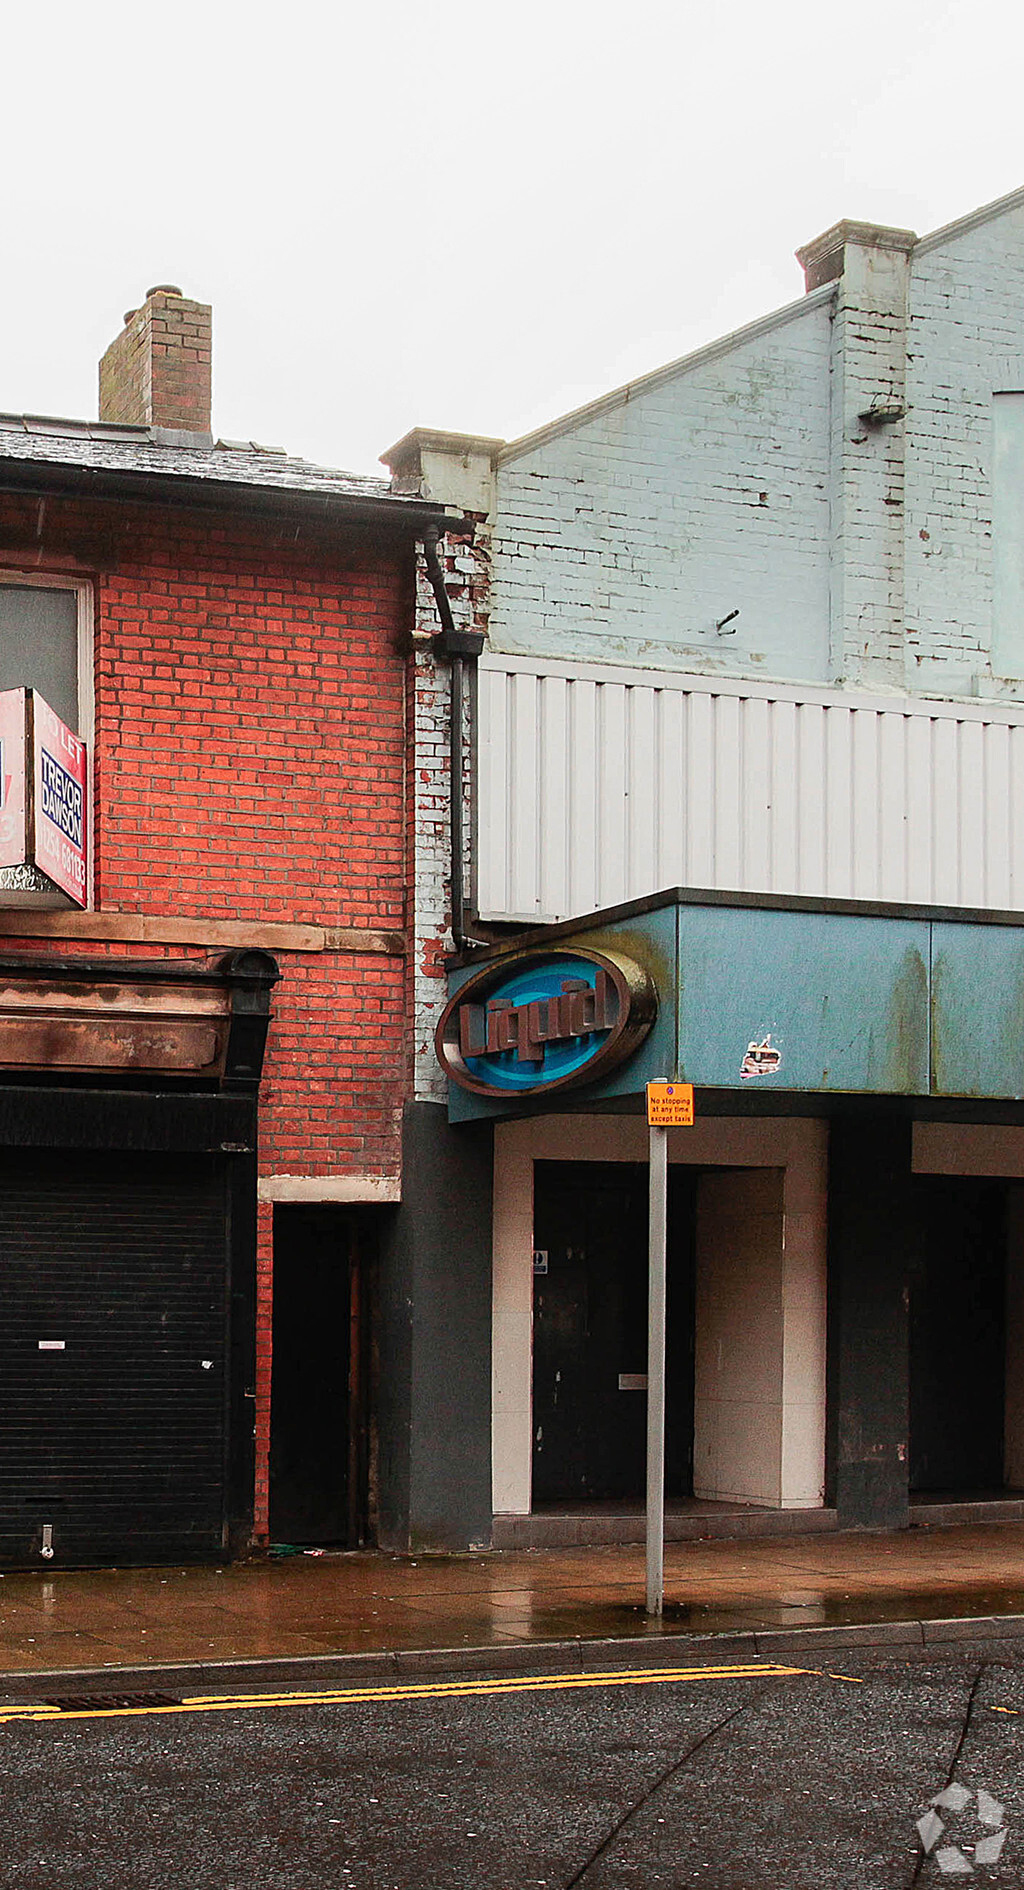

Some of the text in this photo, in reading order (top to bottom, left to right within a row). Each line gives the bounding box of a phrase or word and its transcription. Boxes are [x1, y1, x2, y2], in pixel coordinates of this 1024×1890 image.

[60, 726, 83, 764] LET
[42, 751, 82, 817] TREVOR
[42, 781, 82, 847] DAWSON
[61, 842, 86, 886] 681133
[662, 1097, 691, 1106] stopping
